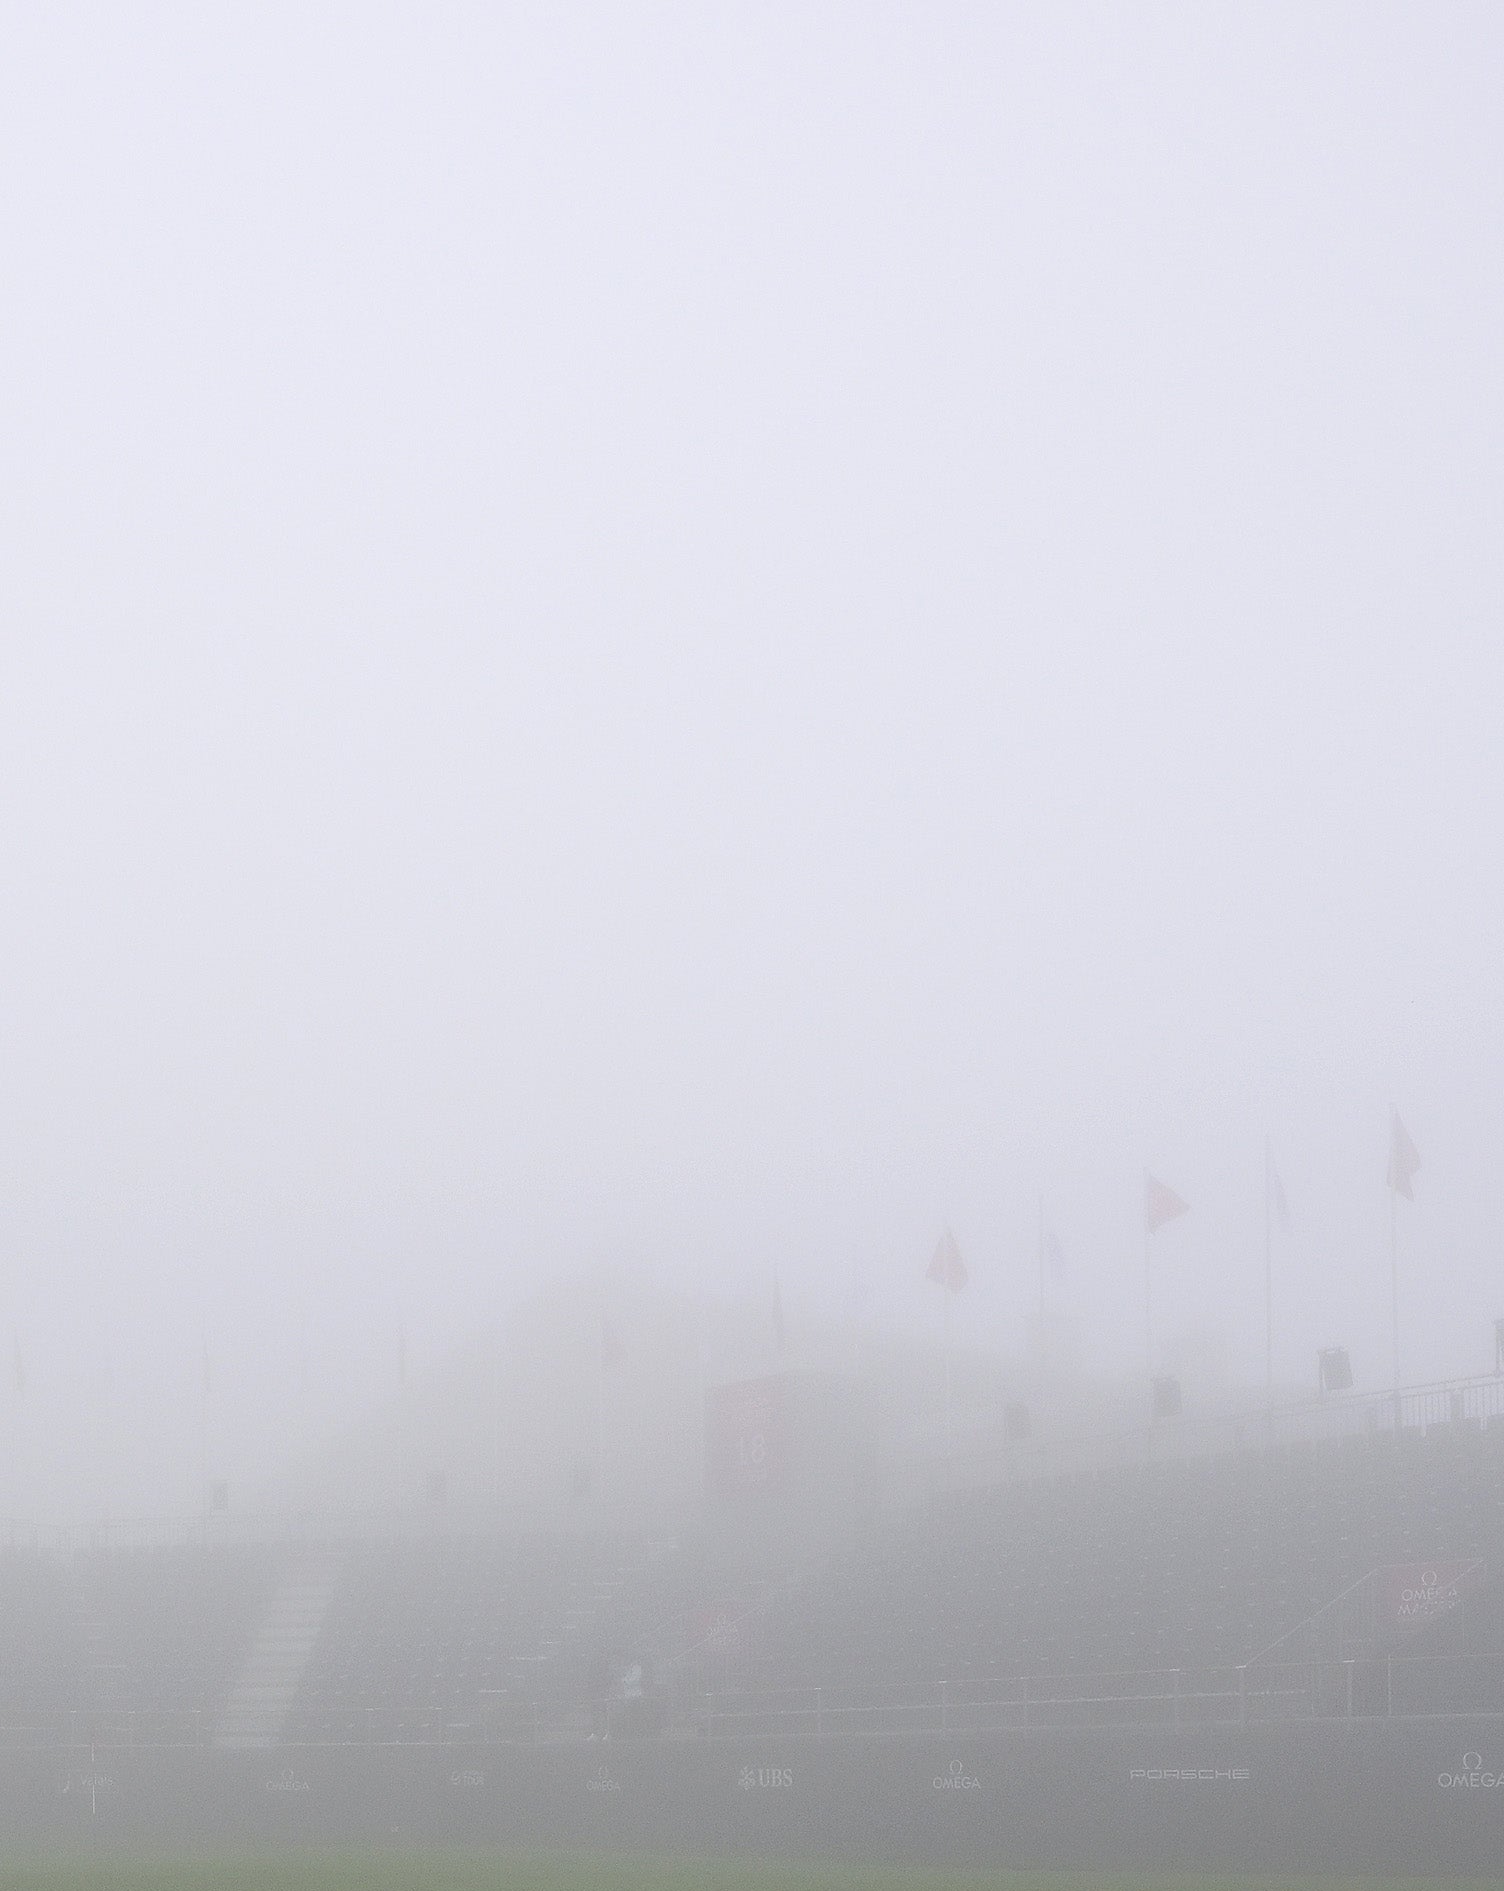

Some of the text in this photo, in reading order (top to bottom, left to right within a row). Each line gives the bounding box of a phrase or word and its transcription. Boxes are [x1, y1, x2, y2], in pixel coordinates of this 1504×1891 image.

[737, 1433, 766, 1465] 18
[757, 1768, 793, 1788] UBS
[1129, 1769, 1250, 1780] PORSCHE
[265, 1780, 310, 1791] OMEGA
[586, 1780, 621, 1792] OMEGA
[932, 1776, 982, 1790] OMEGA
